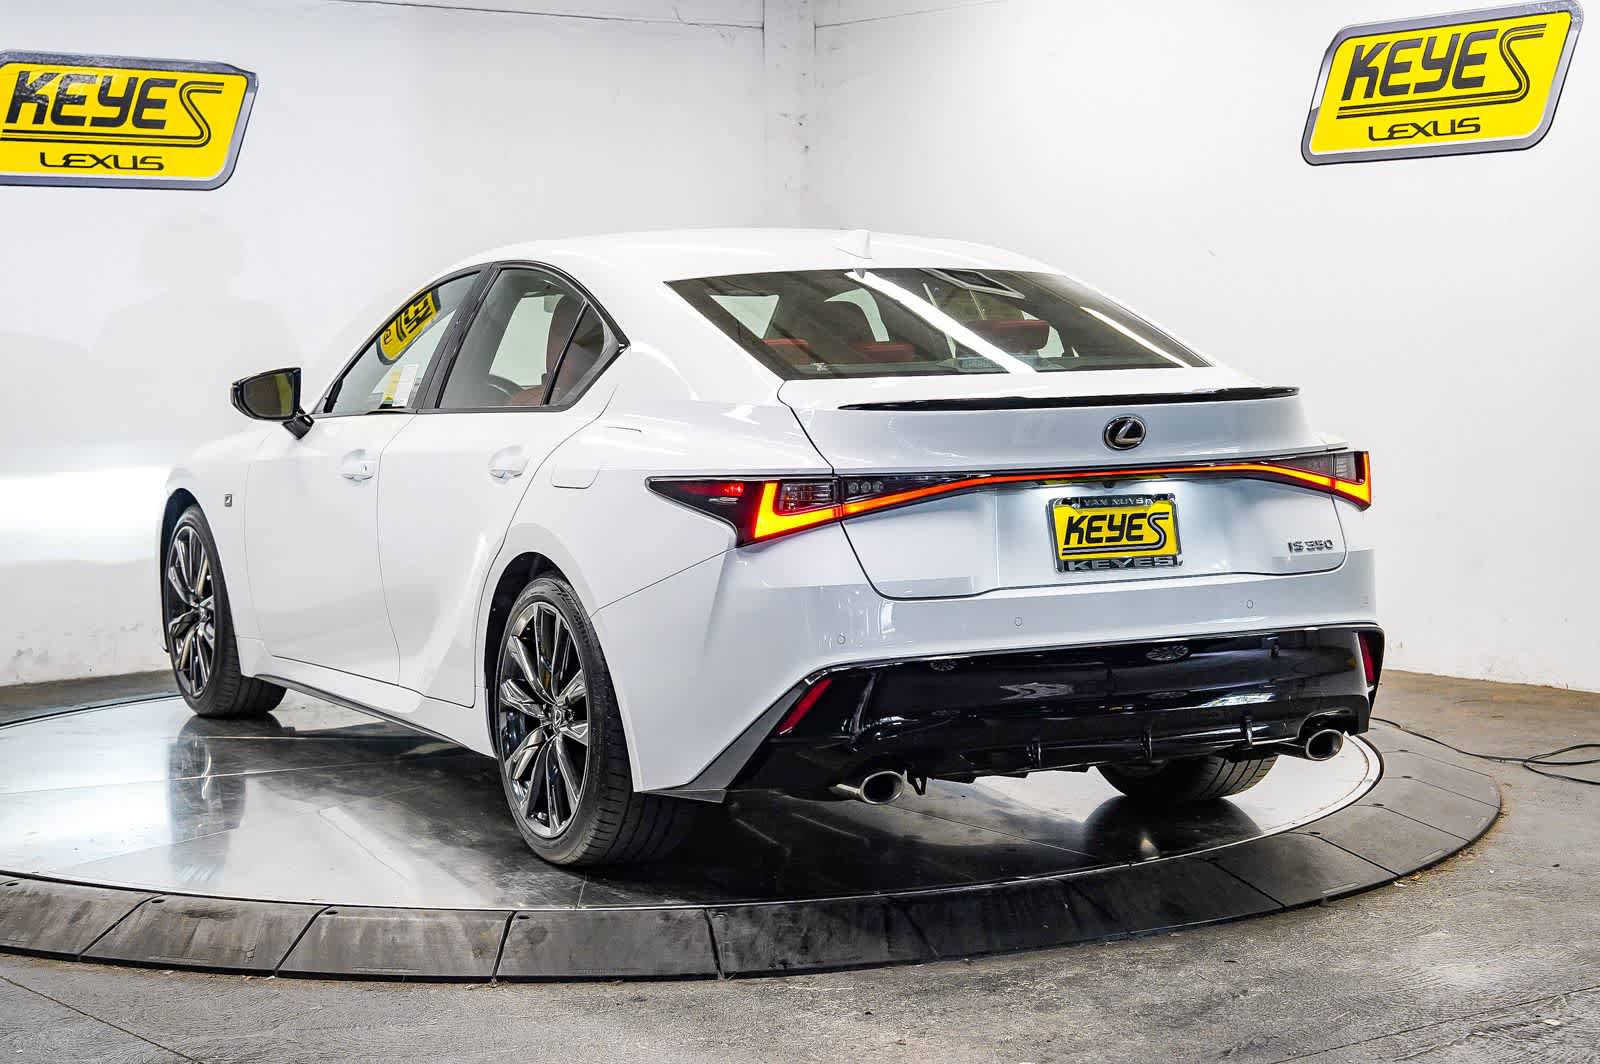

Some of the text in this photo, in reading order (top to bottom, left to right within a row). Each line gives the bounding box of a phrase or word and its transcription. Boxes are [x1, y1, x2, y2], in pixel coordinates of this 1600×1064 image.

[1336, 23, 1547, 119] KEYES
[1, 71, 224, 148] KEYES
[1368, 117, 1481, 141] LEXUS
[40, 152, 164, 171] LEXUS
[1062, 512, 1170, 556] KEYES
[1068, 556, 1174, 571] KEYES
